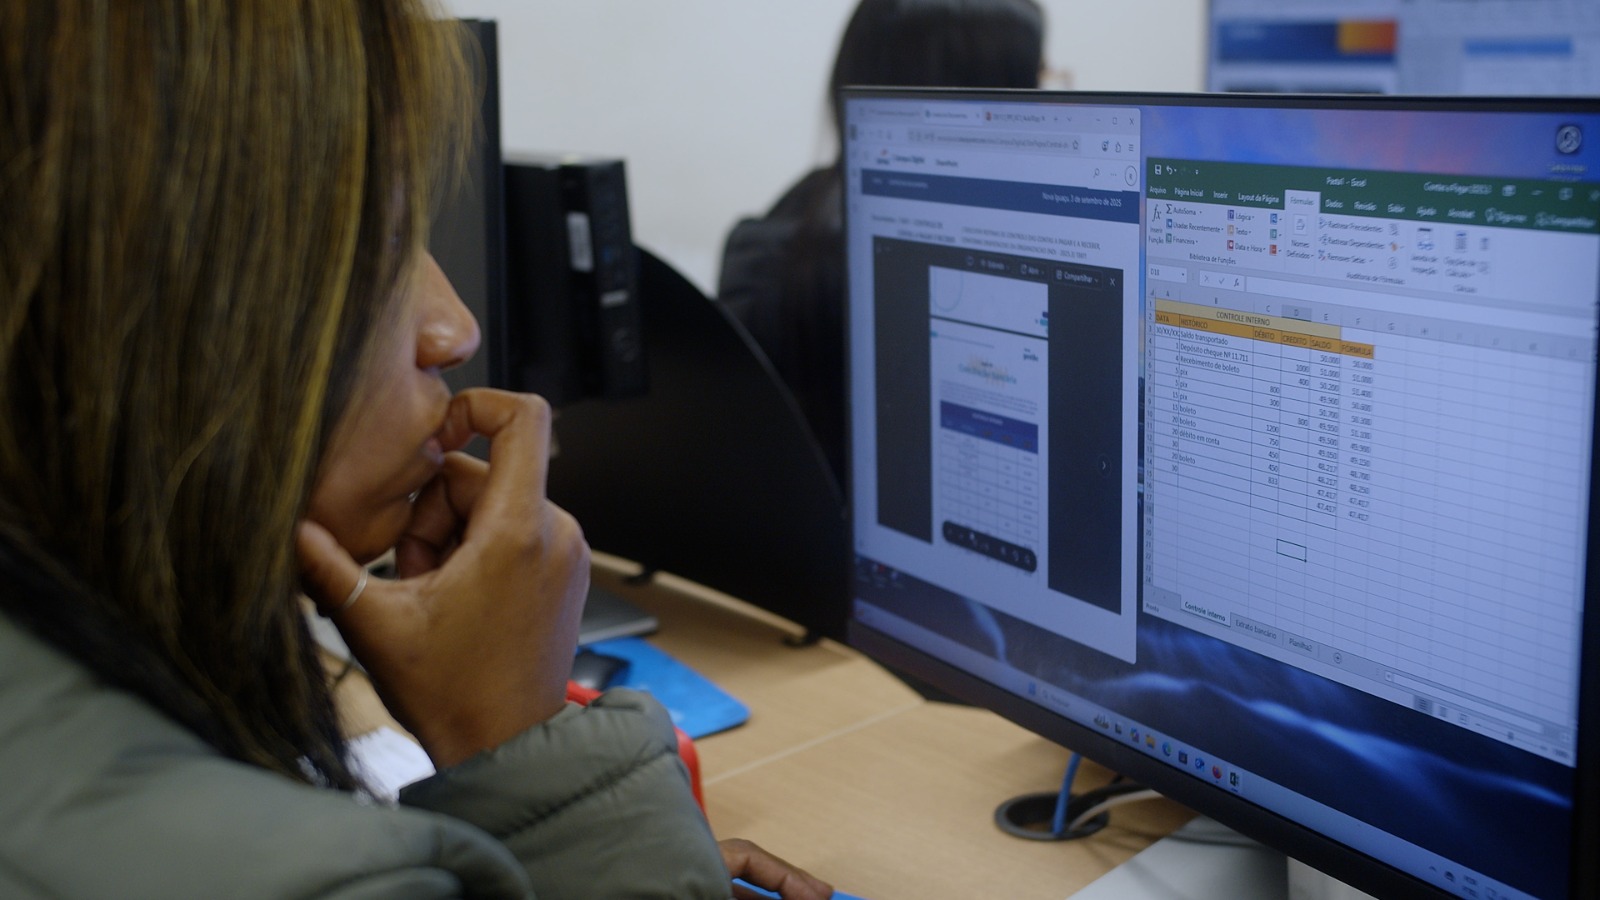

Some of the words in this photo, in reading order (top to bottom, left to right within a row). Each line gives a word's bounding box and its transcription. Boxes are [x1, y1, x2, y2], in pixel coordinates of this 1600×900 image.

[1149, 186, 1167, 195] Arquivo
[1213, 191, 1228, 199] Inserir
[1110, 198, 1122, 207] 2025
[1173, 207, 1197, 216] AutoSoma
[1235, 213, 1252, 223] Lógica
[1188, 223, 1221, 233] Recentemente
[1236, 228, 1248, 236] Texto
[1172, 236, 1196, 245] Financeira
[1235, 243, 1247, 251] Data
[1250, 245, 1263, 253] Hora
[1156, 314, 1170, 323] DATA
[1180, 318, 1208, 329] HISTÓRICO
[1216, 311, 1245, 323] CONTROLE
[1246, 315, 1271, 326] INTERNO
[1180, 331, 1194, 340] Saldo
[1195, 334, 1228, 346] transportado
[1254, 330, 1275, 340] DÉBITO
[1311, 340, 1332, 350] SALDO
[1180, 343, 1202, 354] Depósito
[1203, 347, 1222, 358] cheque
[1180, 355, 1214, 369] Recebimento
[1222, 364, 1240, 374] boleto
[1296, 364, 1310, 372] 1000
[1180, 368, 1188, 376] pix
[1180, 405, 1196, 415] boleto
[1180, 418, 1196, 428] boleto
[1266, 424, 1280, 433] 1200
[1180, 430, 1196, 440] débito
[1206, 437, 1220, 446] conta
[1269, 438, 1279, 446] 750
[1179, 454, 1196, 464] boleto
[1268, 451, 1278, 459] 450
[1268, 464, 1278, 472] 450
[1268, 477, 1278, 485] 833
[1184, 601, 1206, 615] Controle
[1206, 607, 1226, 622] interno
[1236, 620, 1254, 632] Extrato
[1254, 624, 1276, 640] bancário
[1289, 638, 1312, 652] Planilha2
